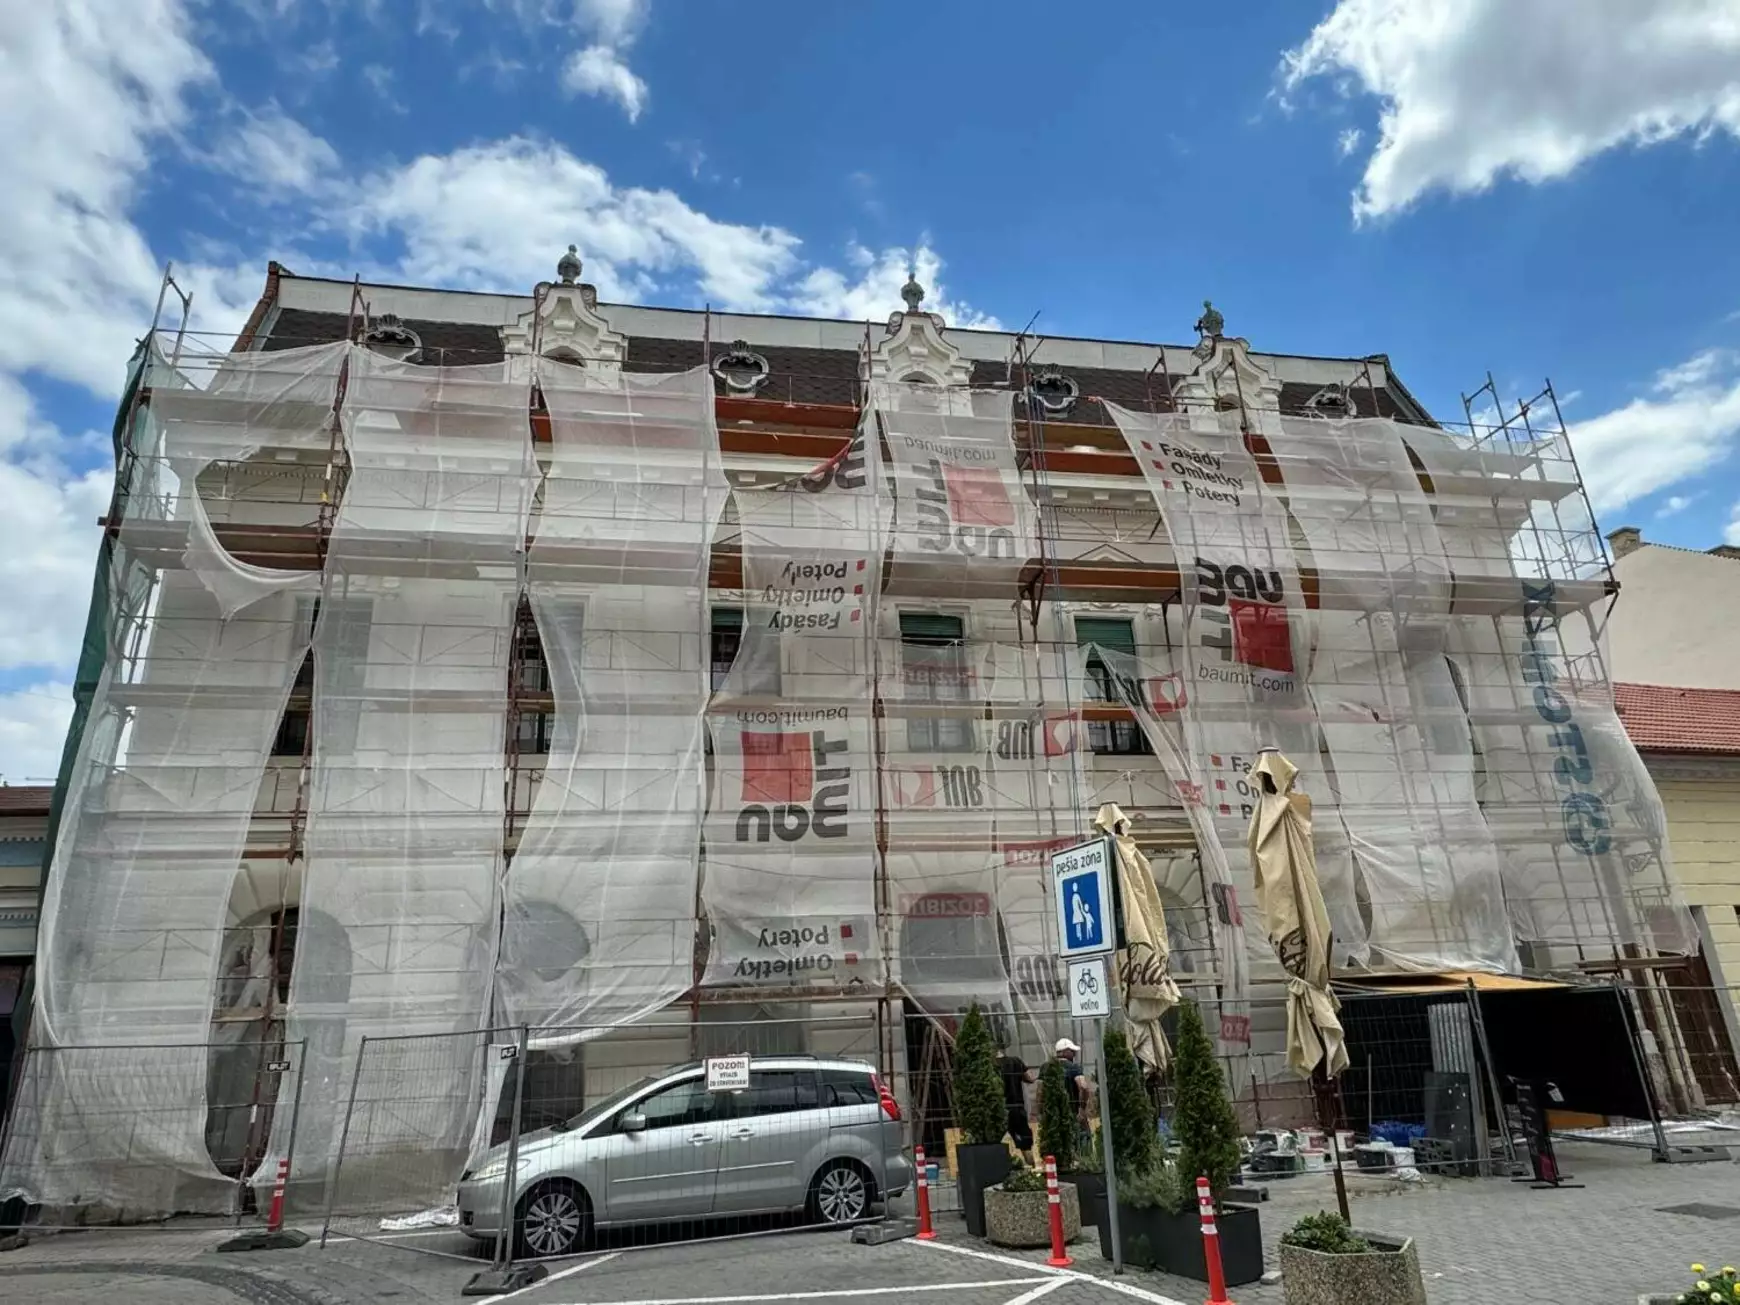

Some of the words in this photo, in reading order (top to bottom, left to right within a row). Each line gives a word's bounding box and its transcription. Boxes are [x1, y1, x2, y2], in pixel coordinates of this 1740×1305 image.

[1159, 442, 1221, 470] Fasády
[1181, 480, 1241, 507] Potery
[782, 561, 848, 582] Potery
[768, 611, 841, 634] Fasády
[1199, 663, 1295, 694] baumit.com
[736, 706, 849, 727] baumit.com
[1056, 854, 1079, 877] pešia
[1080, 850, 1102, 868] zóna
[758, 925, 829, 948] Potery
[734, 953, 833, 979] Omietky
